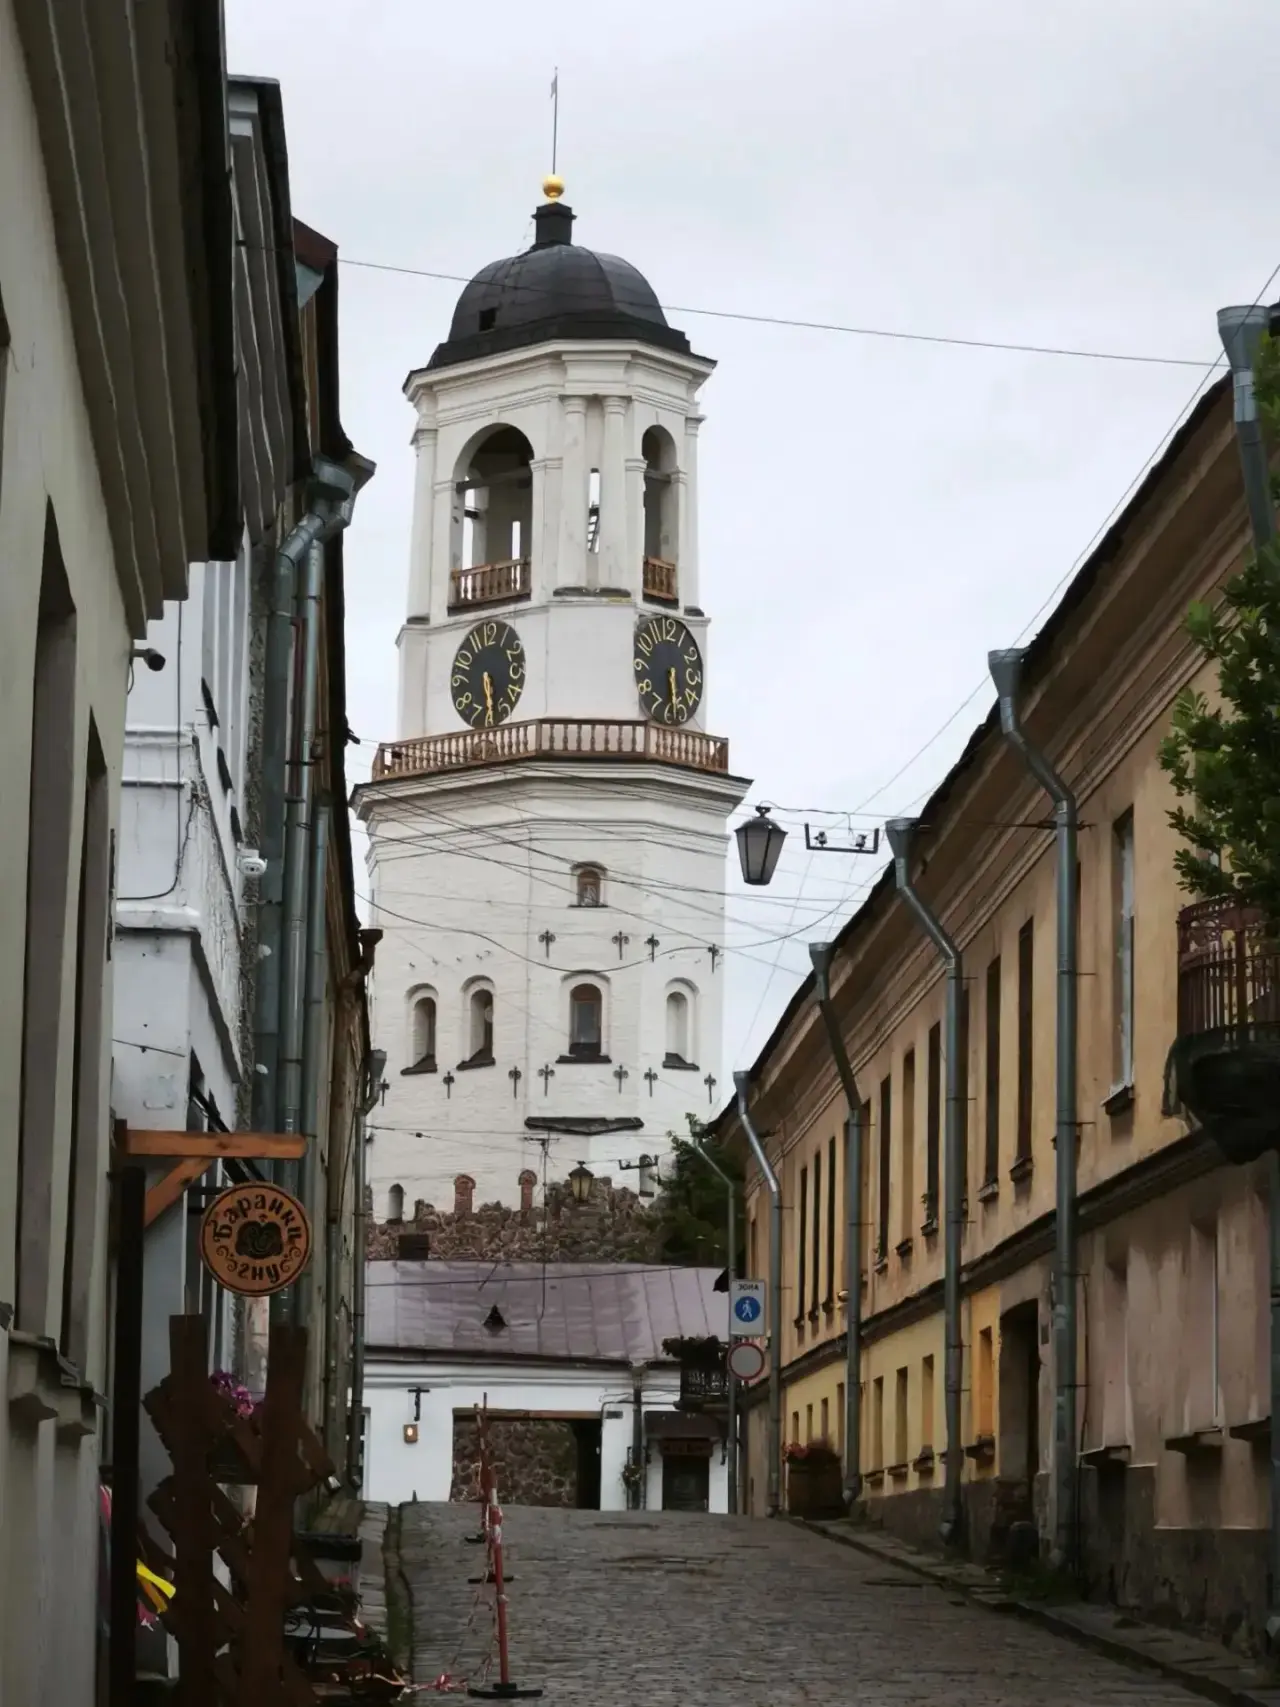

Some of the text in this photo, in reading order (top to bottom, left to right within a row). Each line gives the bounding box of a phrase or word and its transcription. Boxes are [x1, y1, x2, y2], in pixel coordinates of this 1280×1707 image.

[484, 623, 497, 646] 12
[500, 625, 510, 648] 1
[648, 620, 662, 644] 11
[662, 618, 676, 642] 12
[678, 629, 687, 648] 1
[469, 631, 482, 653] 11
[506, 640, 522, 662] 2
[637, 632, 653, 656] 10
[456, 651, 473, 670] 10
[633, 658, 650, 671] 9
[684, 647, 698, 664] 2
[452, 674, 469, 687] 9
[510, 663, 525, 679] 3
[685, 668, 701, 685] 3
[507, 684, 522, 702] 4
[638, 678, 652, 695] 8
[455, 692, 472, 710] 8
[651, 692, 663, 714] 7
[684, 688, 699, 706] 4
[470, 703, 483, 726] 7
[497, 698, 511, 718] 5
[676, 696, 688, 722] 5
[207, 1194, 302, 1242] Баранки
